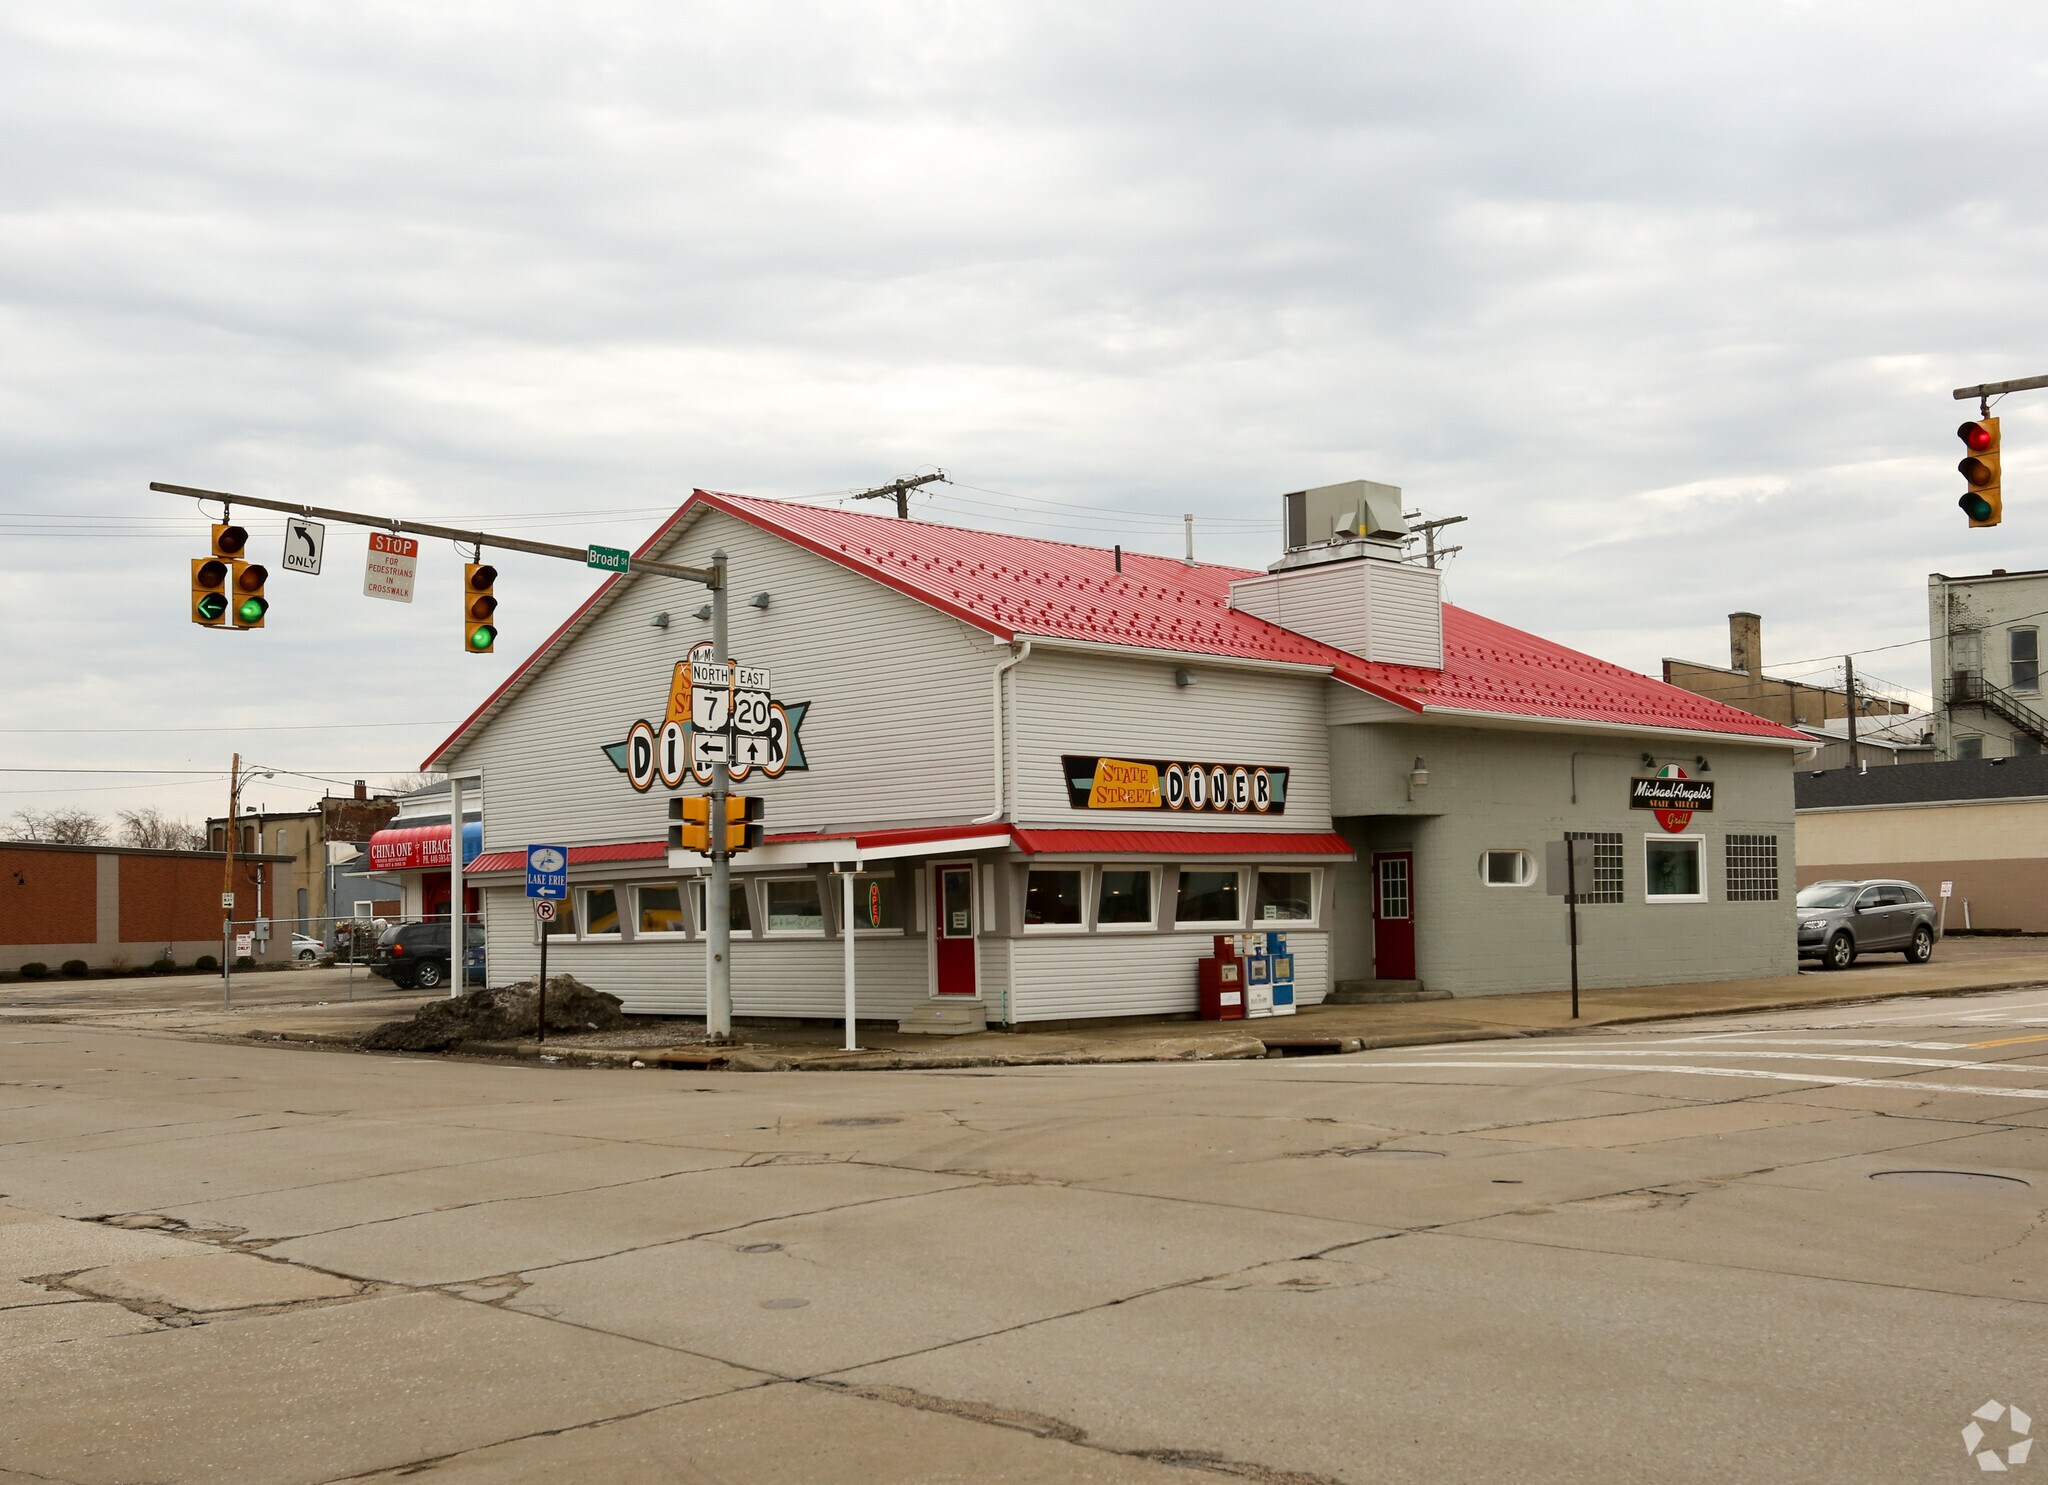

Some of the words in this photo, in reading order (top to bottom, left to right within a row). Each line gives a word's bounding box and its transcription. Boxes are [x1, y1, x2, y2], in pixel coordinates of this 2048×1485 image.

[375, 535, 412, 555] STOP
[288, 554, 317, 569] ONLY
[385, 557, 399, 566] FOR
[590, 550, 619, 567] Broad
[621, 557, 627, 566] St
[368, 564, 413, 578] PEDESTRIANS
[368, 583, 409, 597] CROSSWALK
[693, 666, 728, 682] NORTH
[740, 670, 764, 686] EAST
[704, 696, 718, 721] 7
[738, 699, 767, 725] 20
[634, 717, 783, 779] DiR
[1103, 764, 1149, 784] STATE
[1096, 785, 1156, 805] STREET
[1667, 812, 1688, 828] Grill
[371, 843, 395, 859] CHINA
[396, 842, 413, 857] ONE
[422, 839, 452, 855] HIBACH
[528, 874, 547, 885] LAKE
[548, 875, 566, 886] ERIE
